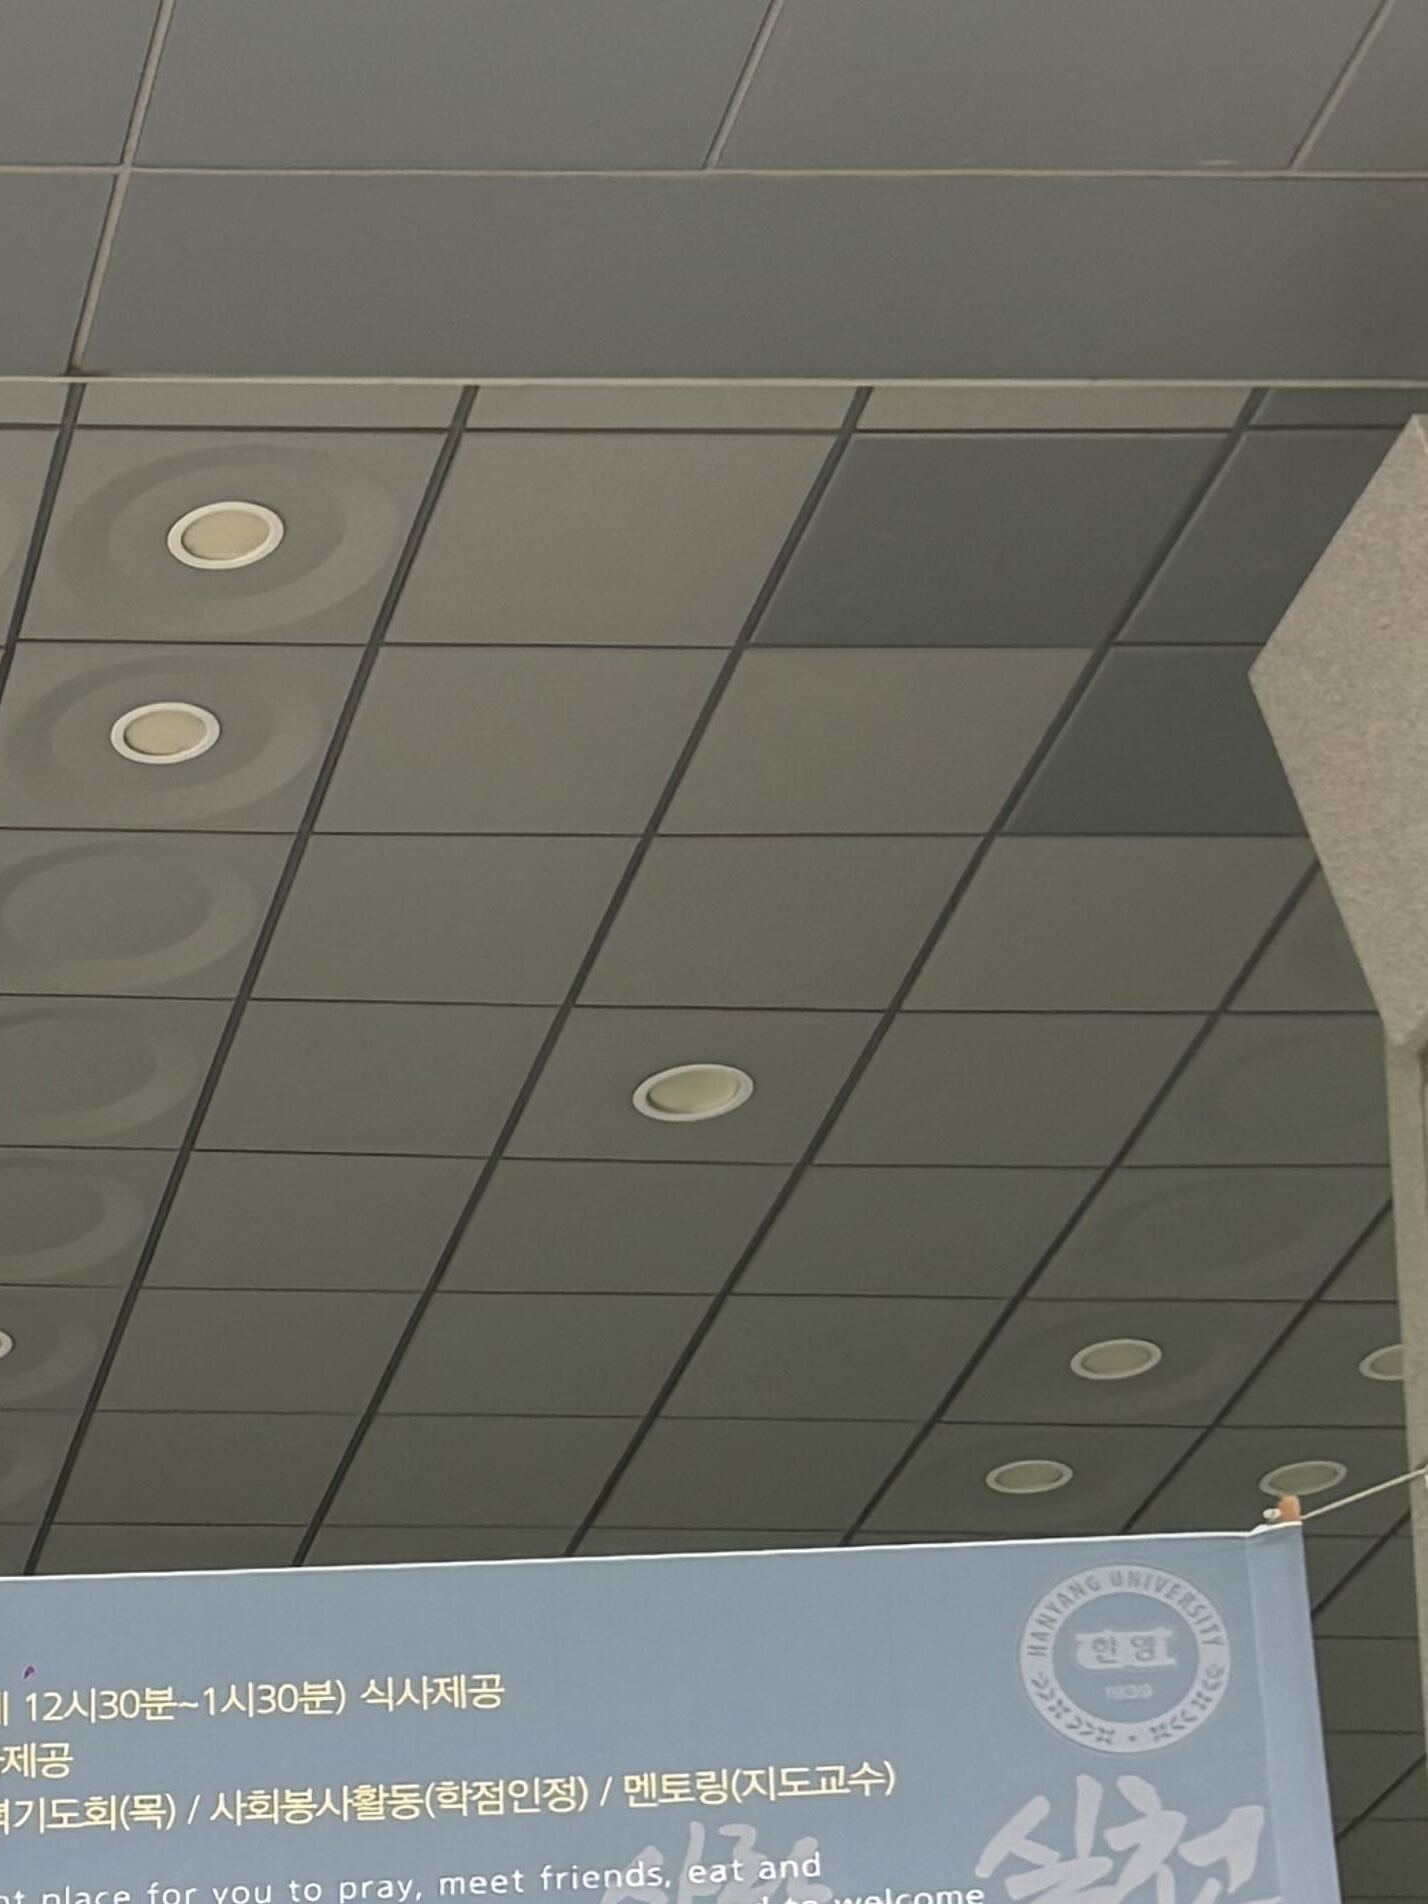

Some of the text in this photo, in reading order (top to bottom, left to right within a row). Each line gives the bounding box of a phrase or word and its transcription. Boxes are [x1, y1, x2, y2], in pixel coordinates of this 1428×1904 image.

[25, 1679, 346, 1724] 12시30분~1시30분)
[359, 1673, 506, 1713] 식사제공
[209, 1775, 589, 1827] 사회봉사활동(학점인정)
[623, 1760, 896, 1808] 멘토링(지도교수)
[288, 1880, 322, 1903] to
[339, 1879, 422, 1904] pray,
[439, 1869, 524, 1896] meet
[540, 1859, 671, 1891] friends,
[688, 1858, 744, 1884] eat
[758, 1851, 821, 1880] and
